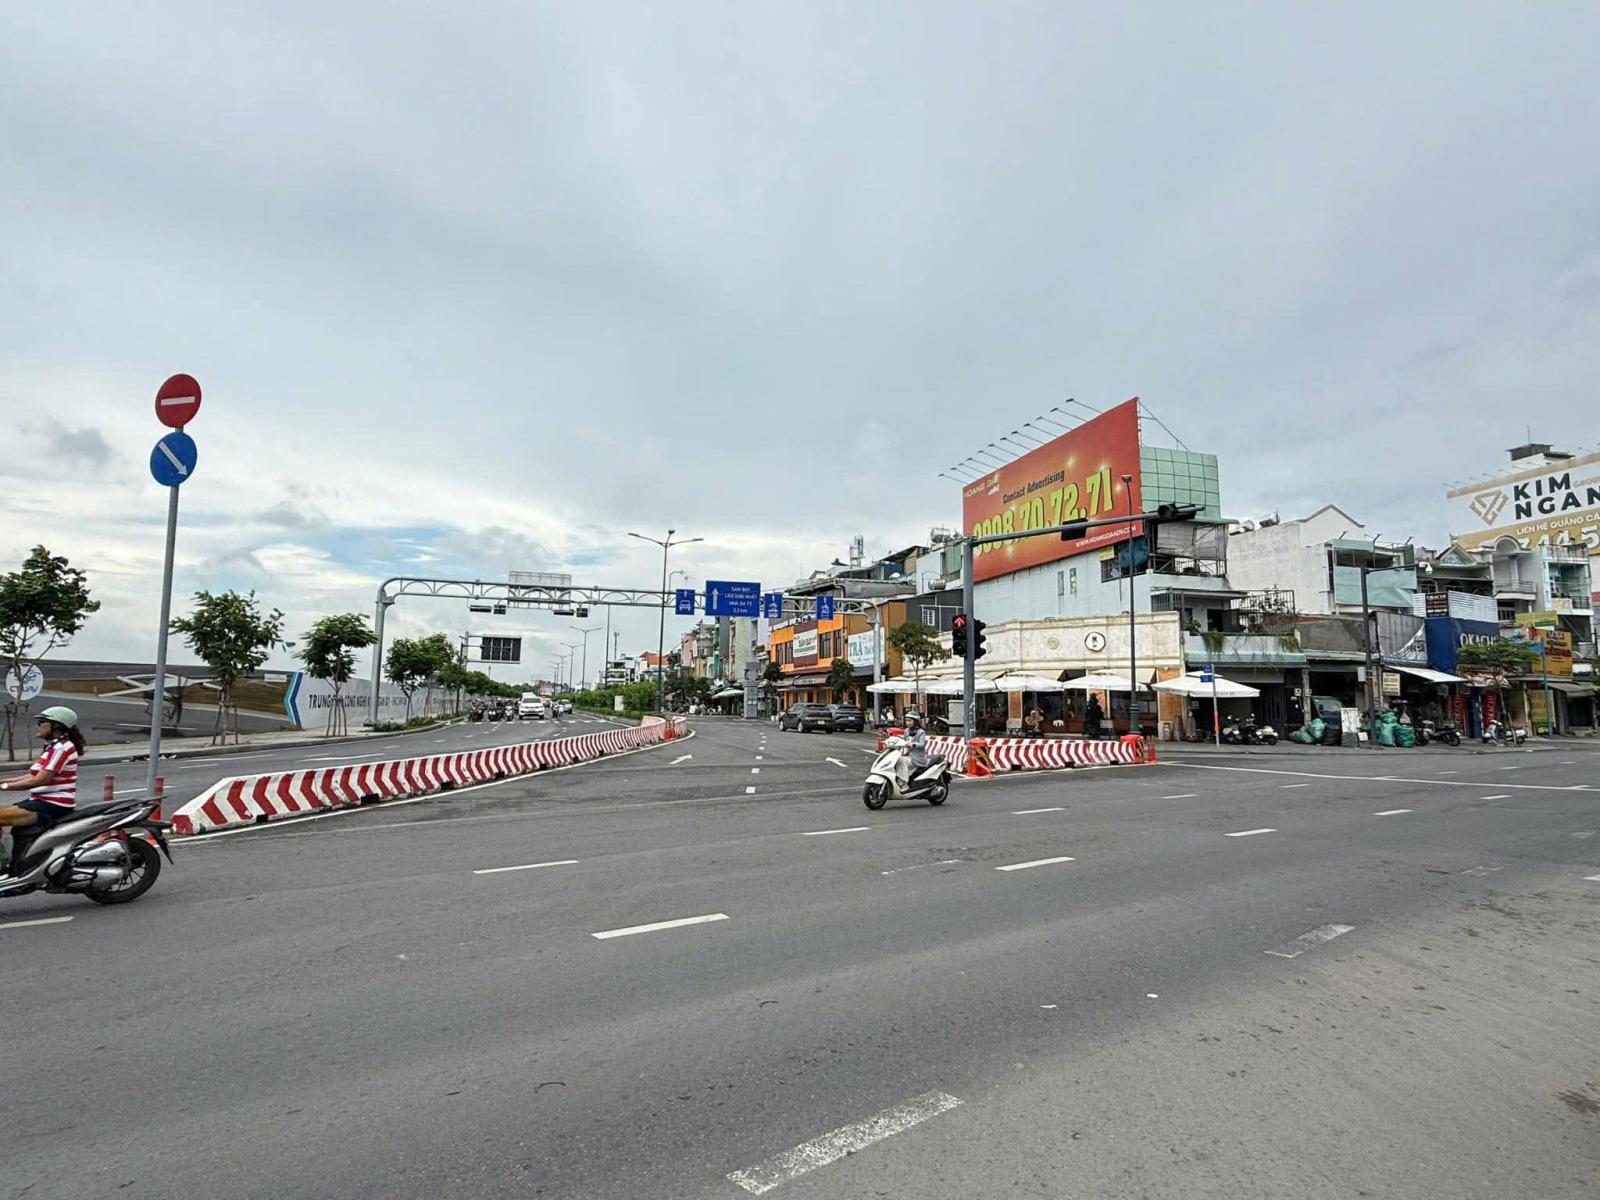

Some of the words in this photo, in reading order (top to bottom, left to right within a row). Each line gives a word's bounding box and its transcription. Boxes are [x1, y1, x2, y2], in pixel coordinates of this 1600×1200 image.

[1002, 487, 1025, 504] Contact
[1027, 469, 1065, 493] Advertising
[1513, 473, 1571, 502] KIM
